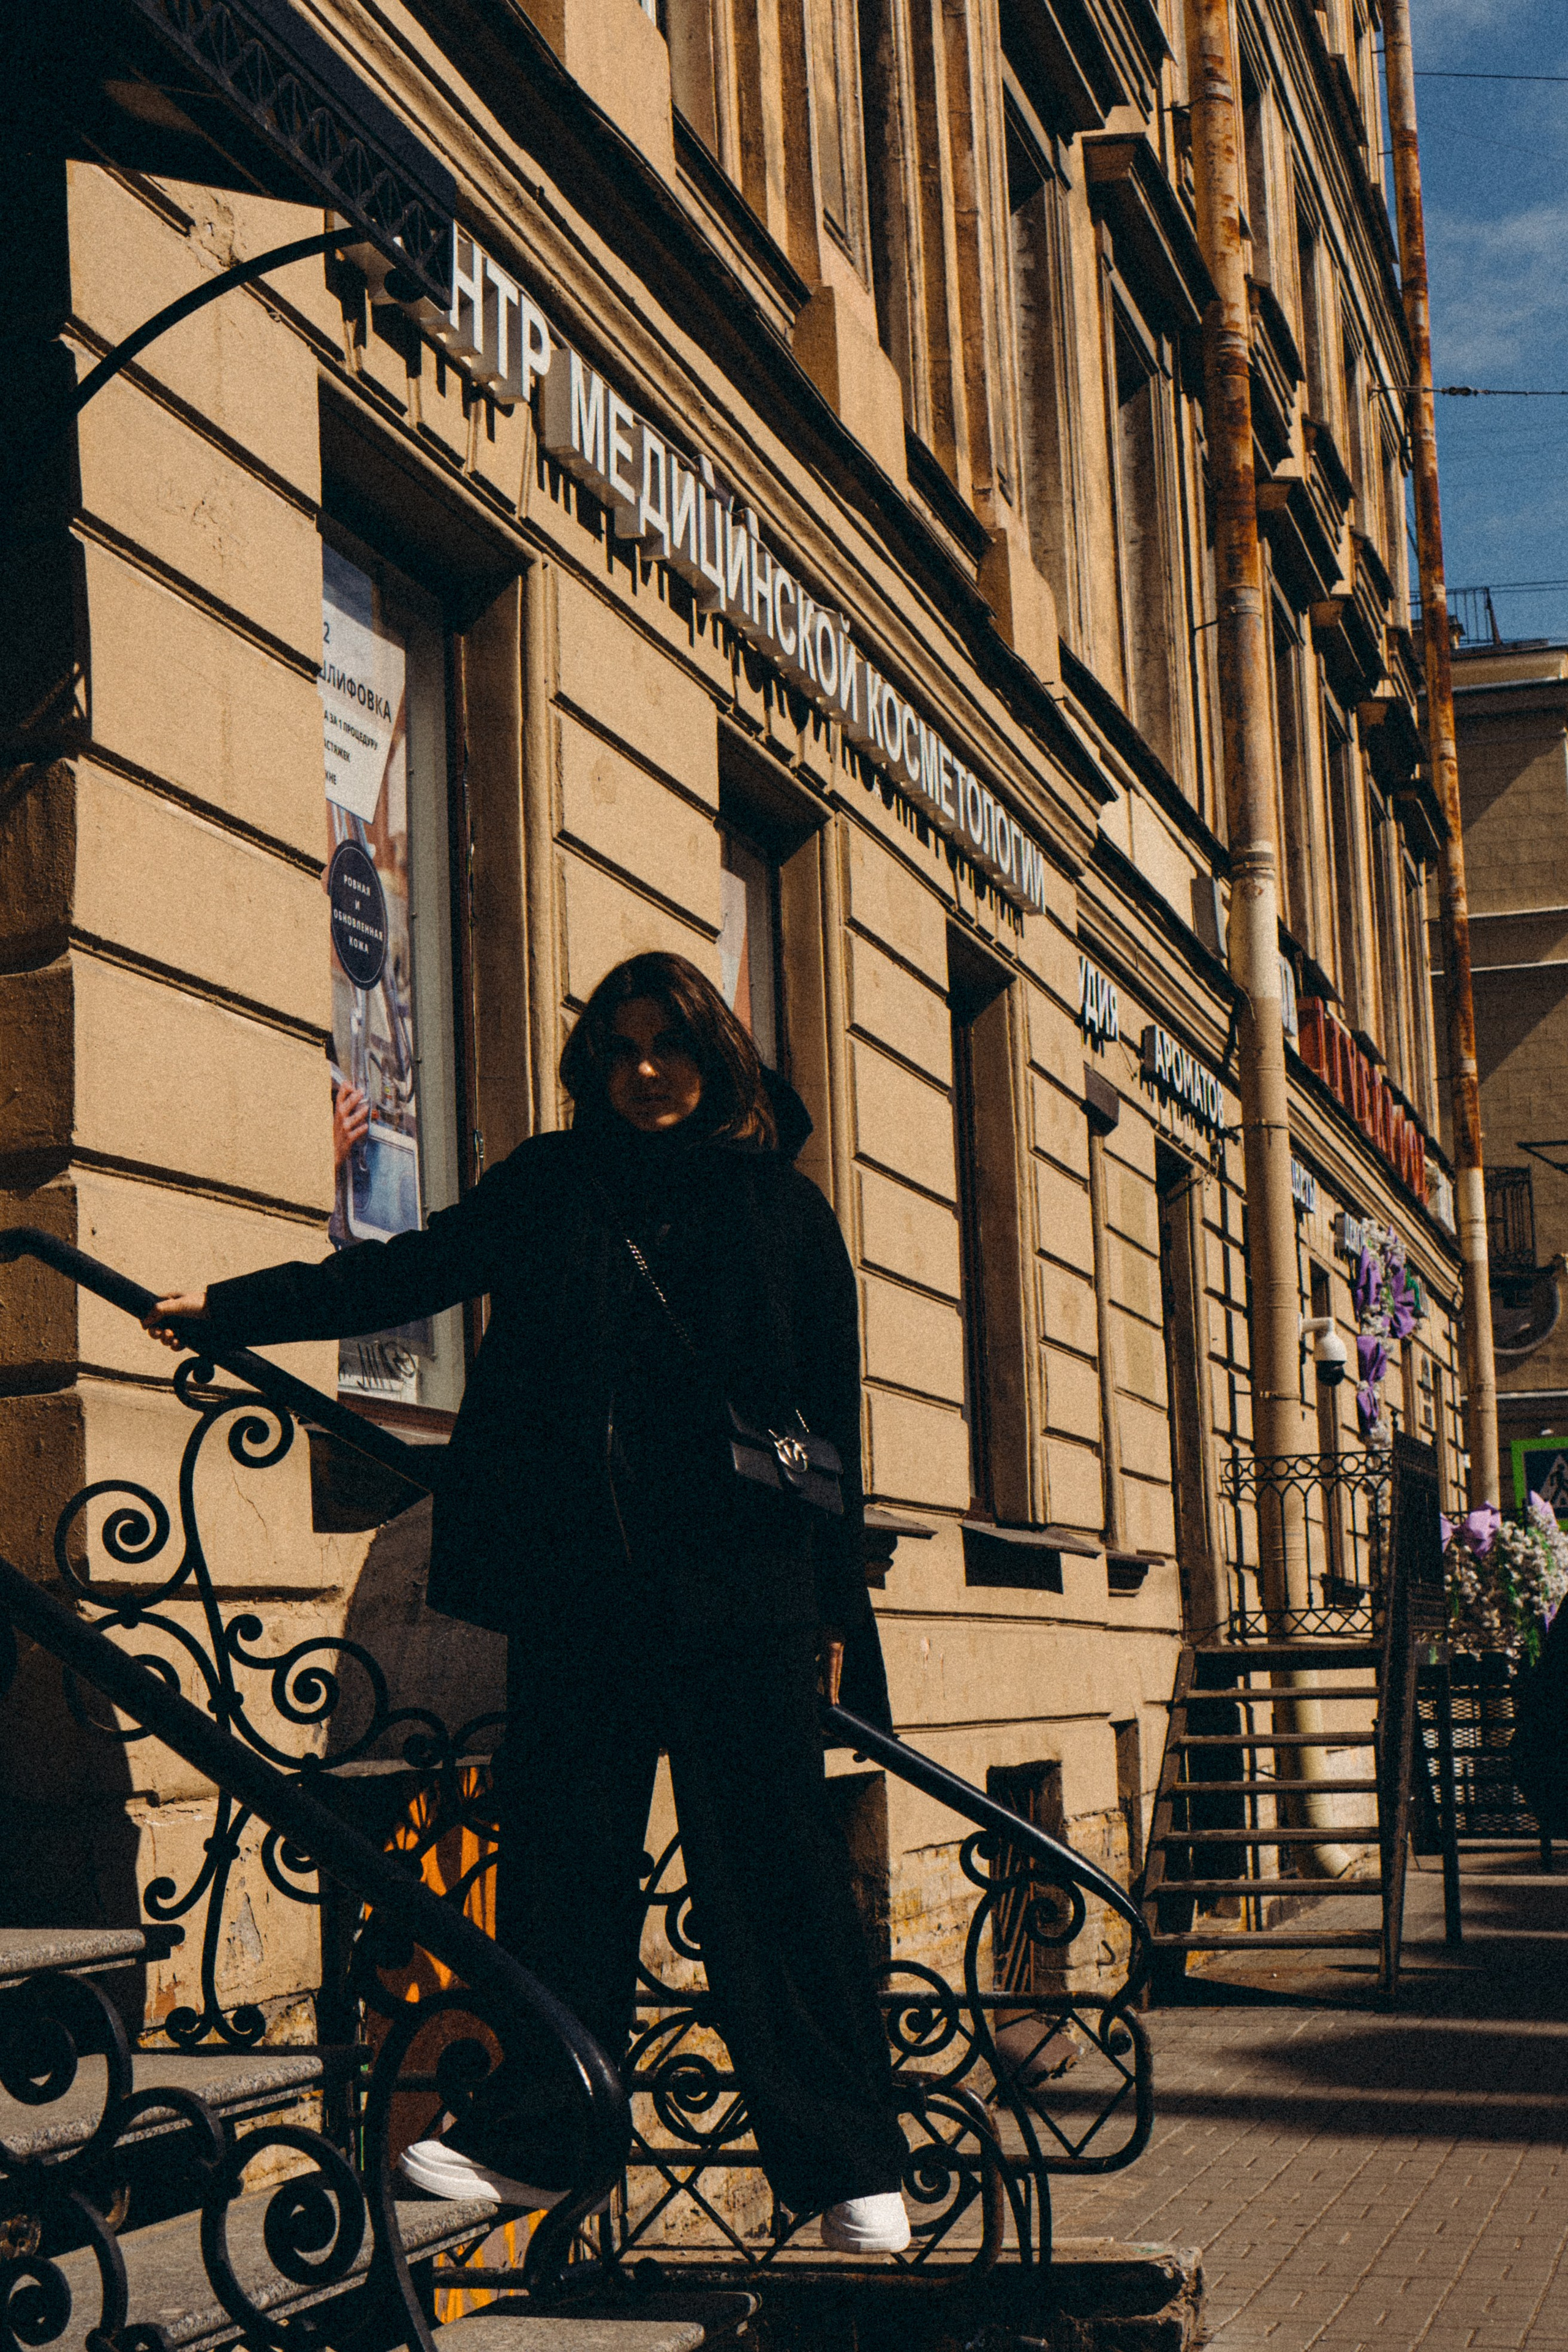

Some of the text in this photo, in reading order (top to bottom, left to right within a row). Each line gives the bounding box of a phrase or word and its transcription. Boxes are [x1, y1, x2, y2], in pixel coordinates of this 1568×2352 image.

[449, 219, 1045, 914] НТР МЕДИЦИНСКОЙ КОСМЕТОЛОГИИ
[330, 712, 337, 725] ЗА
[338, 718, 342, 729] 1
[343, 722, 379, 751] ПРОЦЕДУРУ
[344, 874, 371, 897] РОВНАЯ
[355, 899, 360, 911] И
[333, 908, 383, 941] ОБНОВЛЕННАЯ
[349, 935, 369, 954] КОЖА
[1155, 1025, 1224, 1129] АРОМАТОВ
